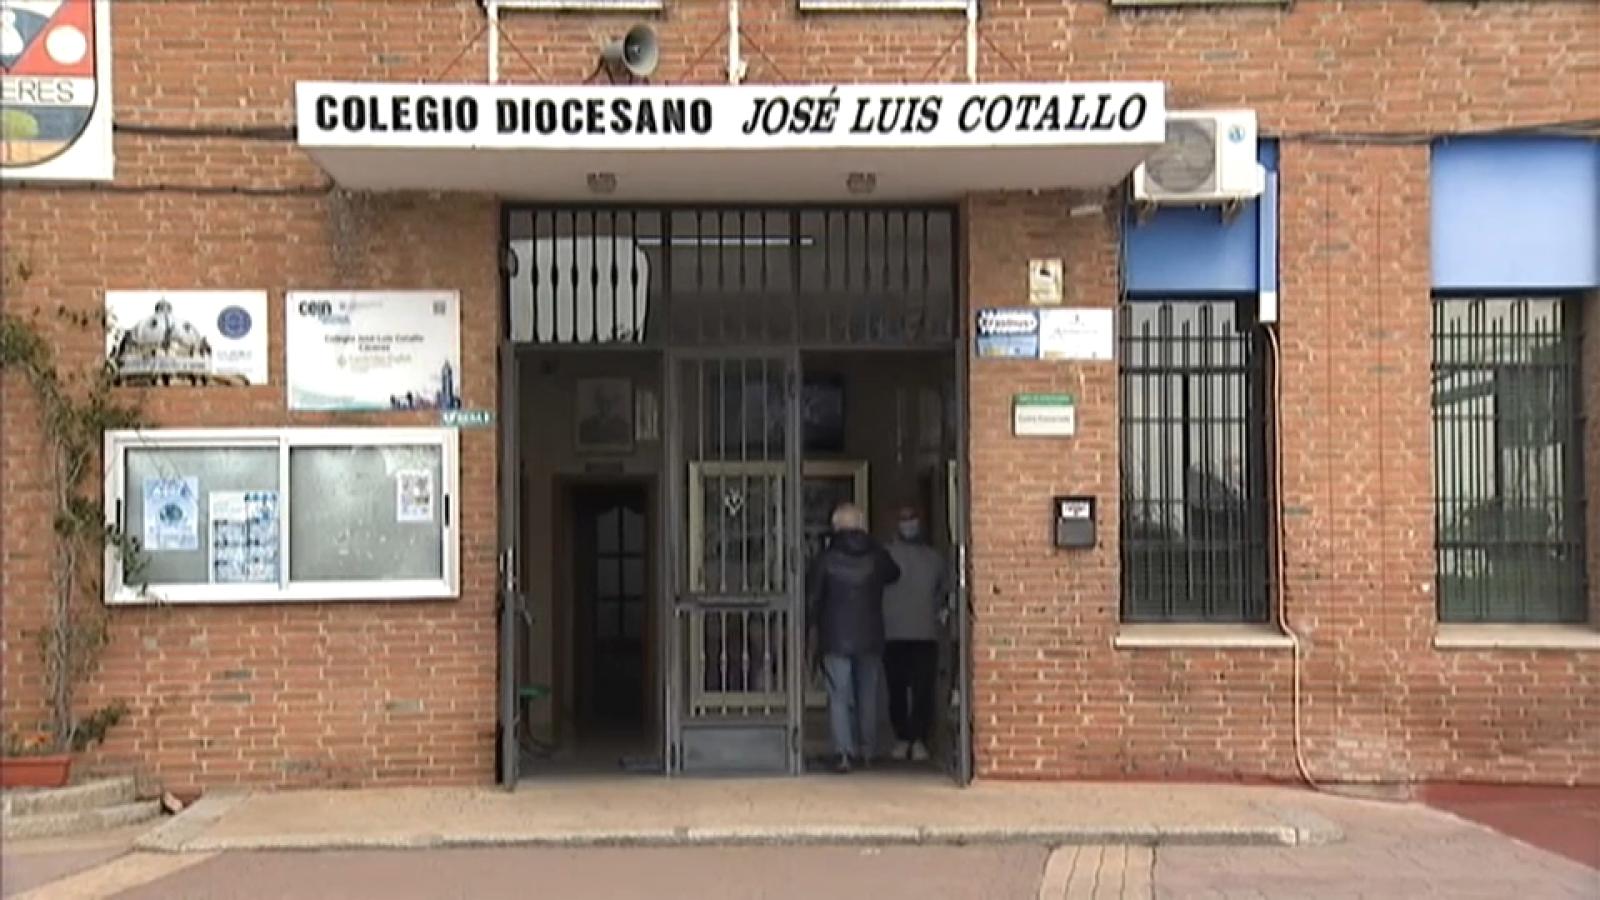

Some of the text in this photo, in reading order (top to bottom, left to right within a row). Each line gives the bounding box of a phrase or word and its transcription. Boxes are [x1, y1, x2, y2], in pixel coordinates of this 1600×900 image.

[0, 79, 75, 103] ERES
[315, 86, 1148, 135] COLEGIO DIOCESANO JOSÉ LUIS COTALLO
